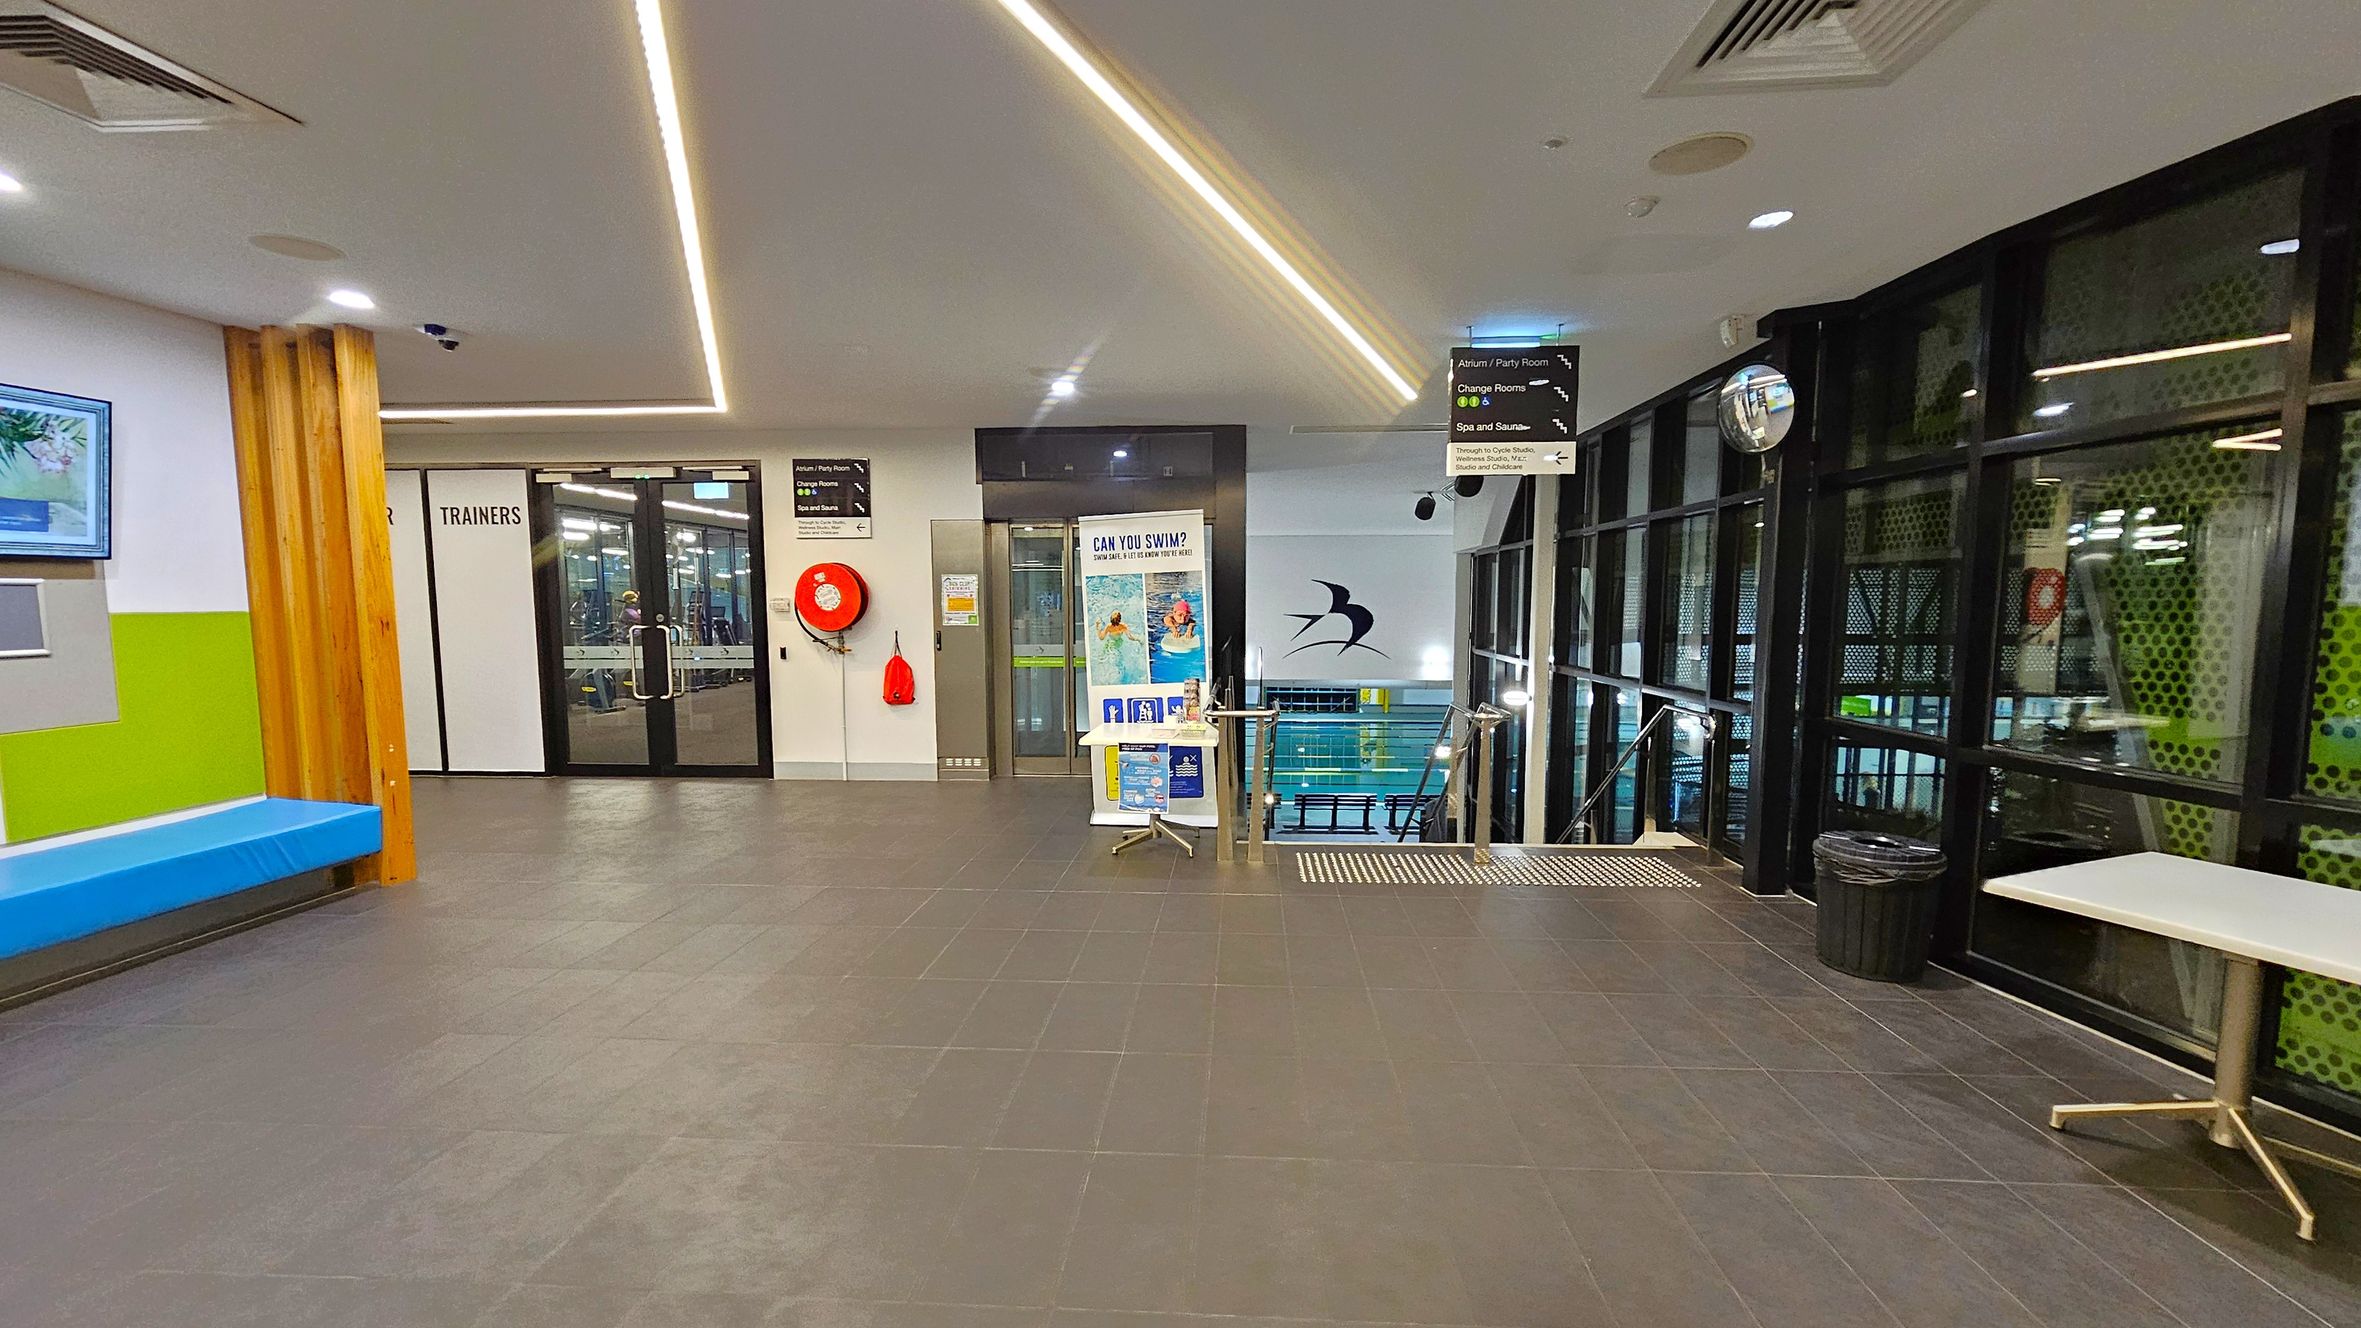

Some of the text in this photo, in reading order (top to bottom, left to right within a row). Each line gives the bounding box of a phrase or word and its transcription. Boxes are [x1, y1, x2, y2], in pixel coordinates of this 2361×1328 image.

[1458, 359, 1487, 368] Atrium
[1496, 359, 1519, 368] Party
[1458, 384, 1526, 394] Change Rooms
[1456, 422, 1524, 432] Spa and Sauna
[440, 507, 522, 525] TRAINERS
[1093, 532, 1187, 551] CAN YOU SWIM?
